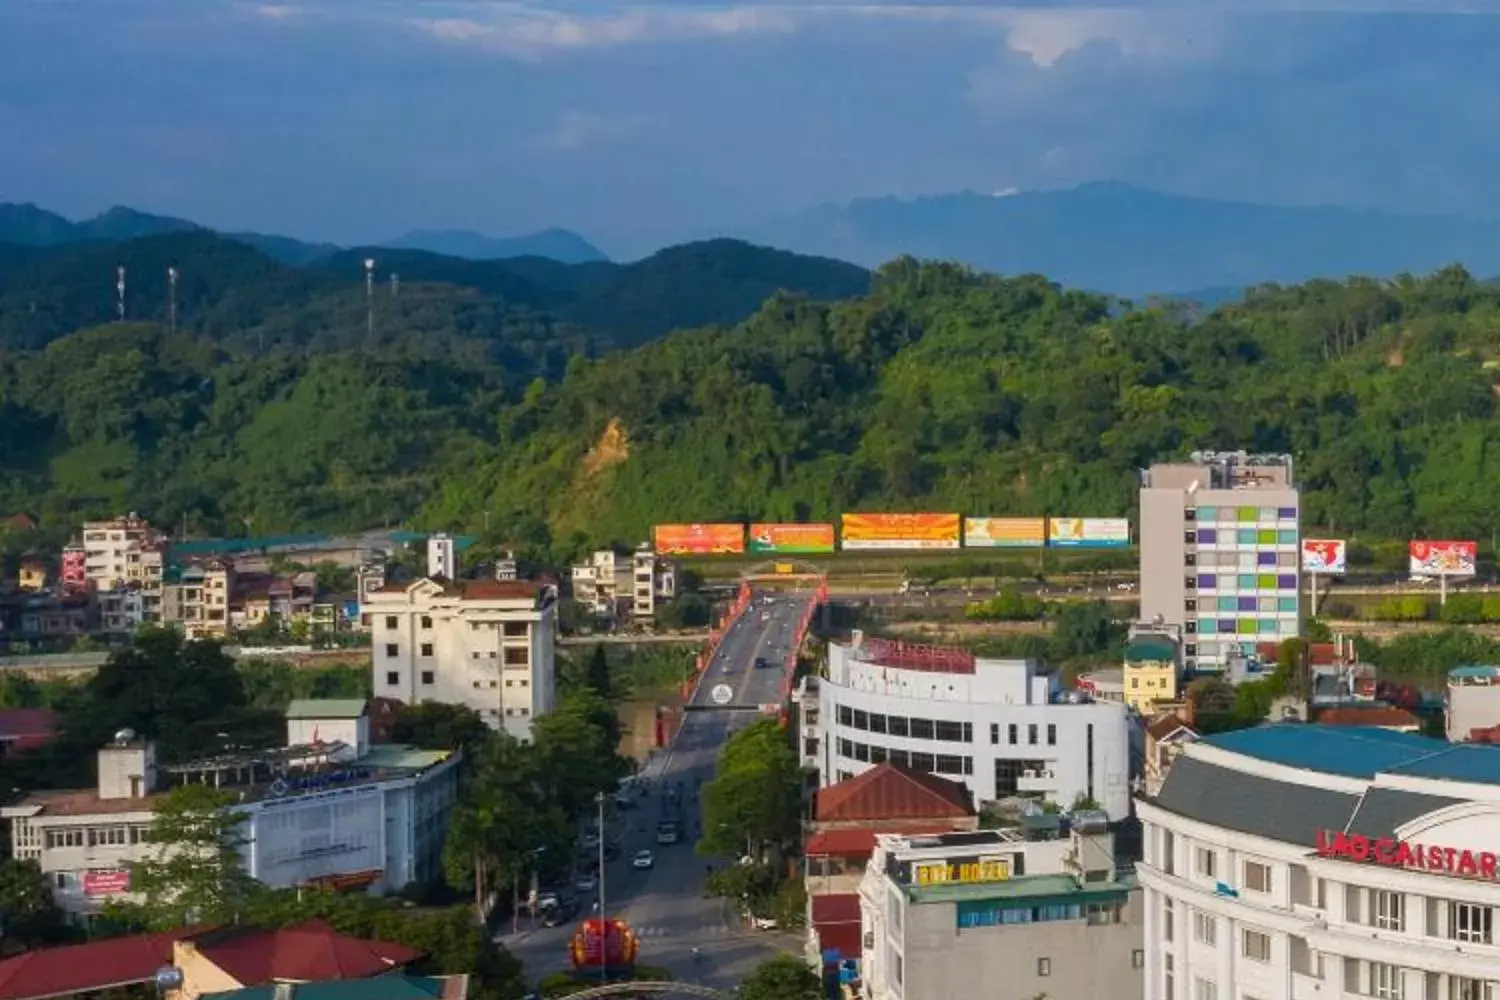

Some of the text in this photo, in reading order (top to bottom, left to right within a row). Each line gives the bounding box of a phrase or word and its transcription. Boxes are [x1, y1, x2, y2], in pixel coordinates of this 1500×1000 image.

[1317, 828, 1369, 862] LAO
[1375, 836, 1425, 867] CAI
[1429, 845, 1496, 877] STAR
